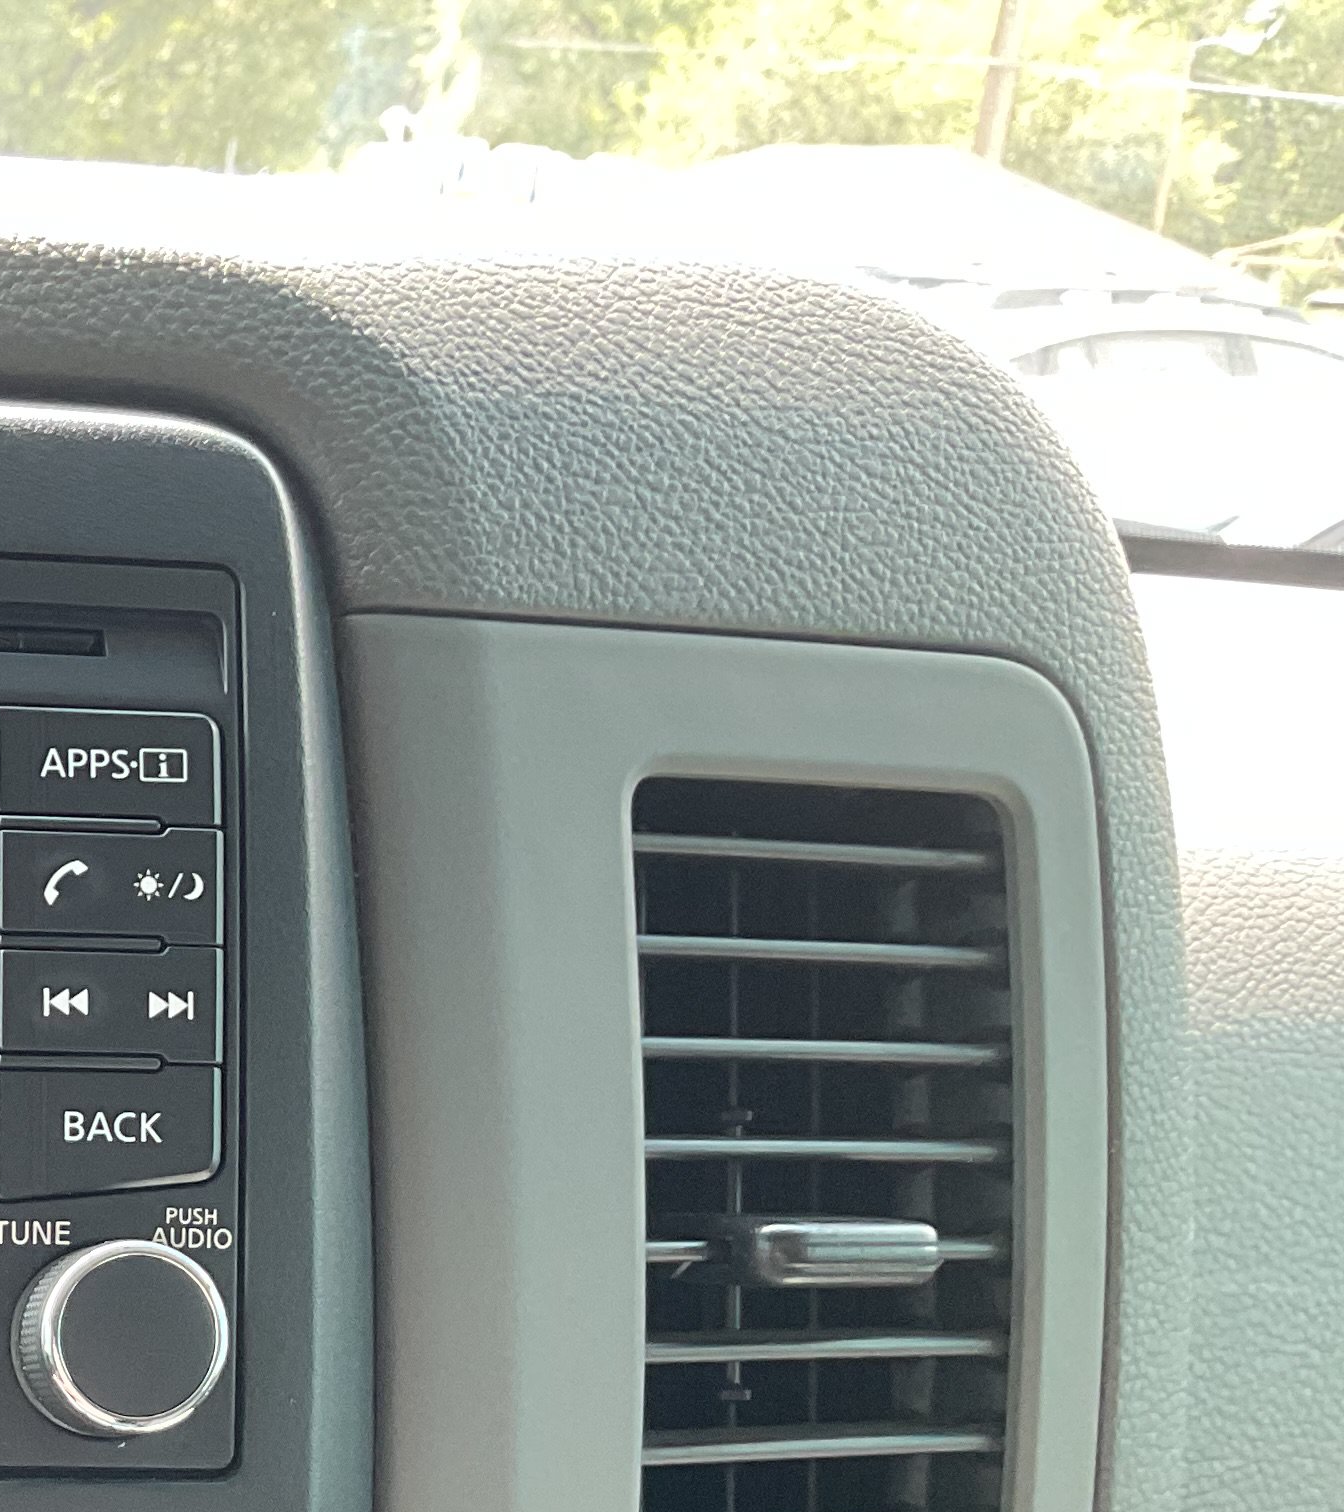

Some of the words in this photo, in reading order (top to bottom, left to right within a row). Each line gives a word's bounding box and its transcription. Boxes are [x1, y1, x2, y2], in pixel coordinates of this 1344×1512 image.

[63, 1110, 163, 1143] BACK
[165, 1207, 218, 1225] PUSH
[152, 1227, 233, 1250] AUDIO
